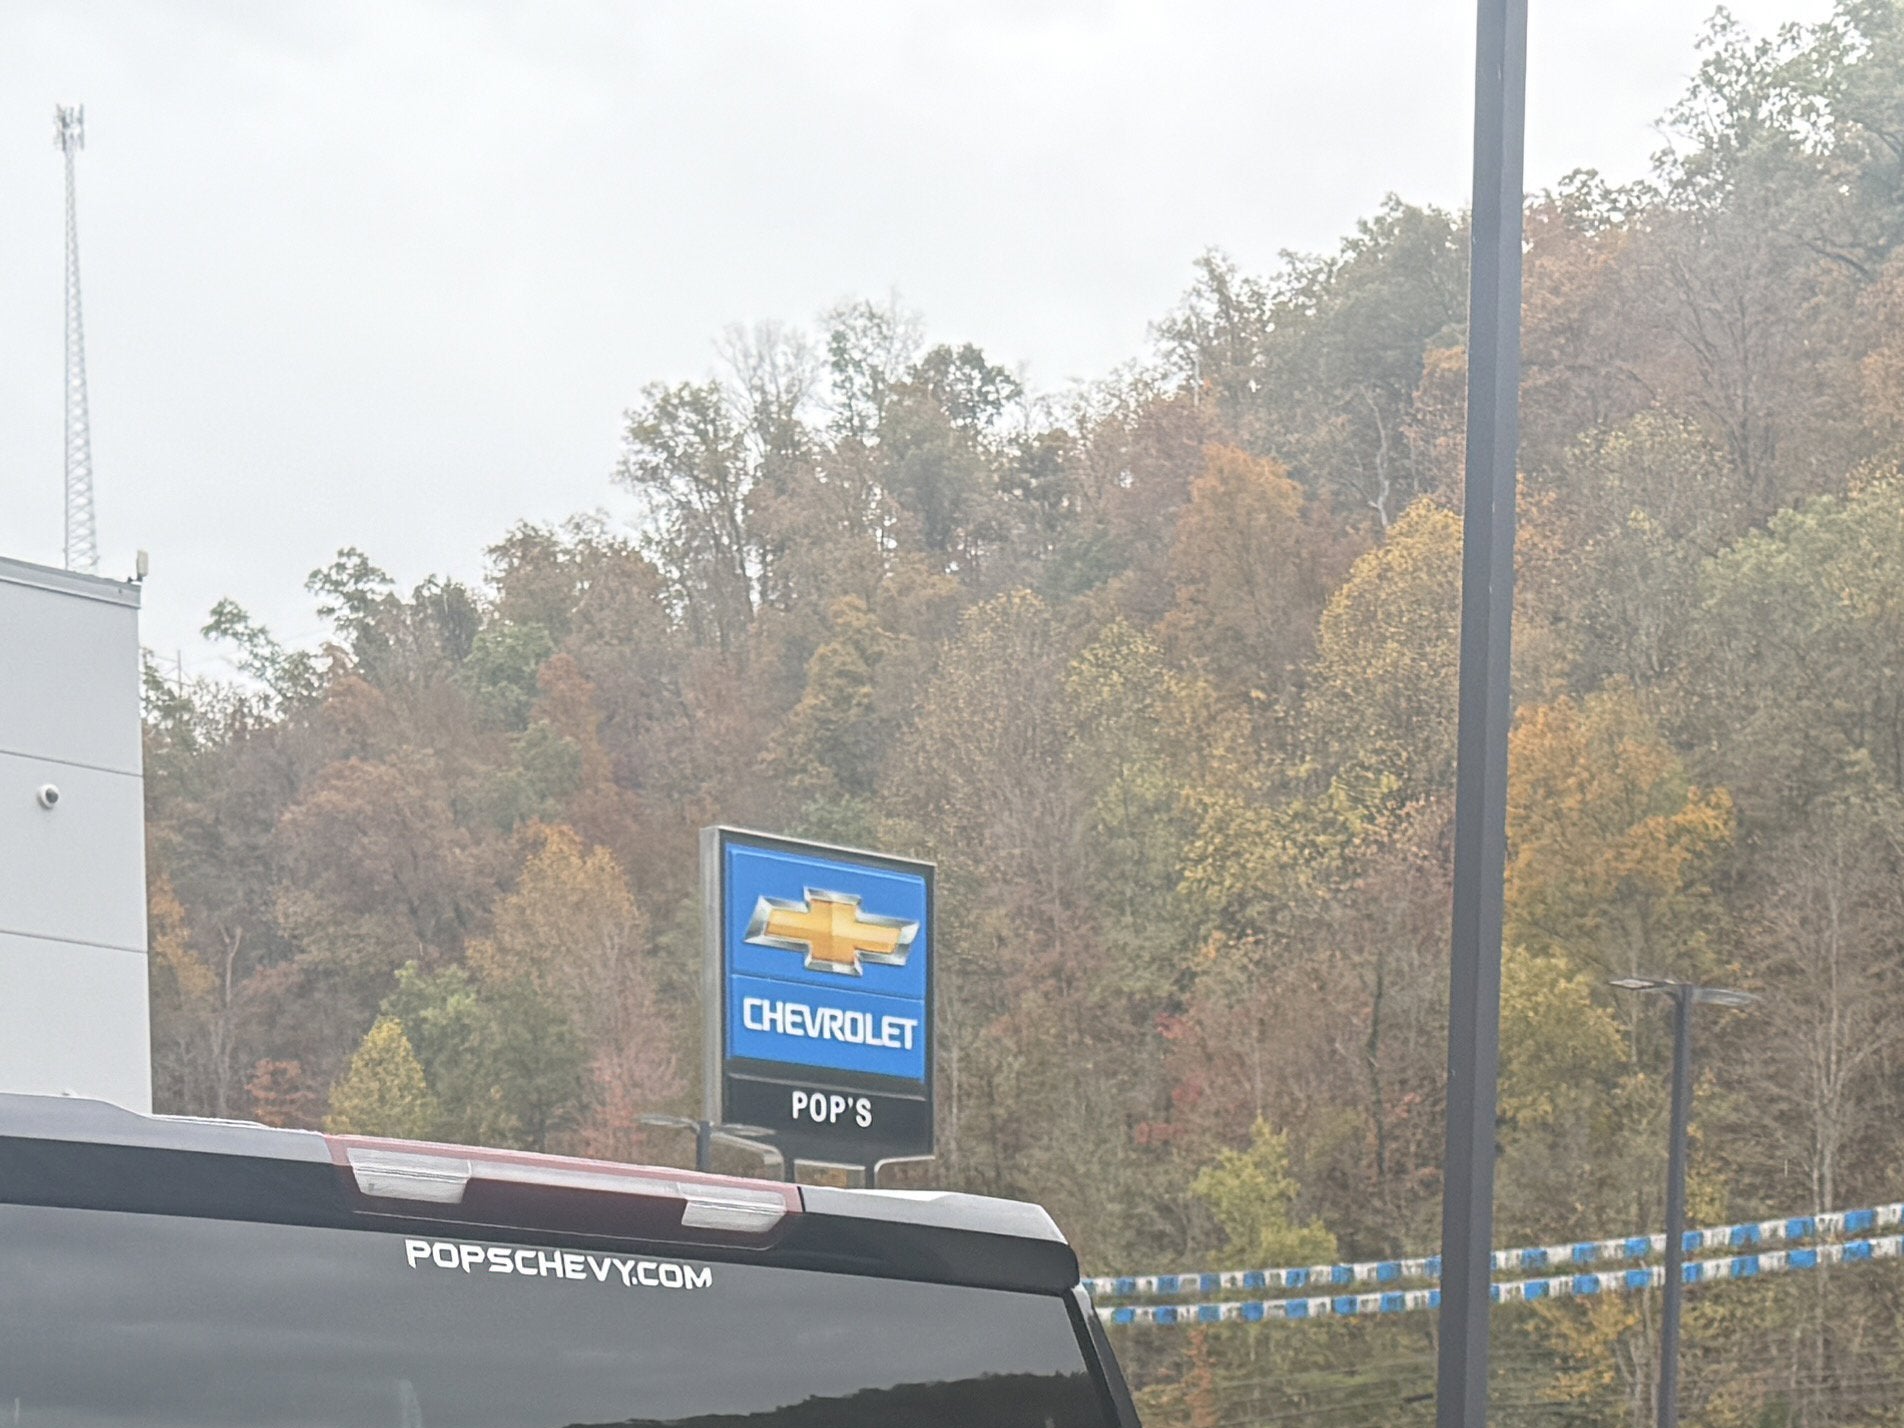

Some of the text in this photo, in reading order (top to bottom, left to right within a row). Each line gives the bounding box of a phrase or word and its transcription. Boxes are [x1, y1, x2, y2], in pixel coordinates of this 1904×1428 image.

[742, 996, 919, 1050] CHEVROLET
[791, 1090, 874, 1128] POP'S
[404, 1238, 714, 1290] POPSCHEVY.COM
